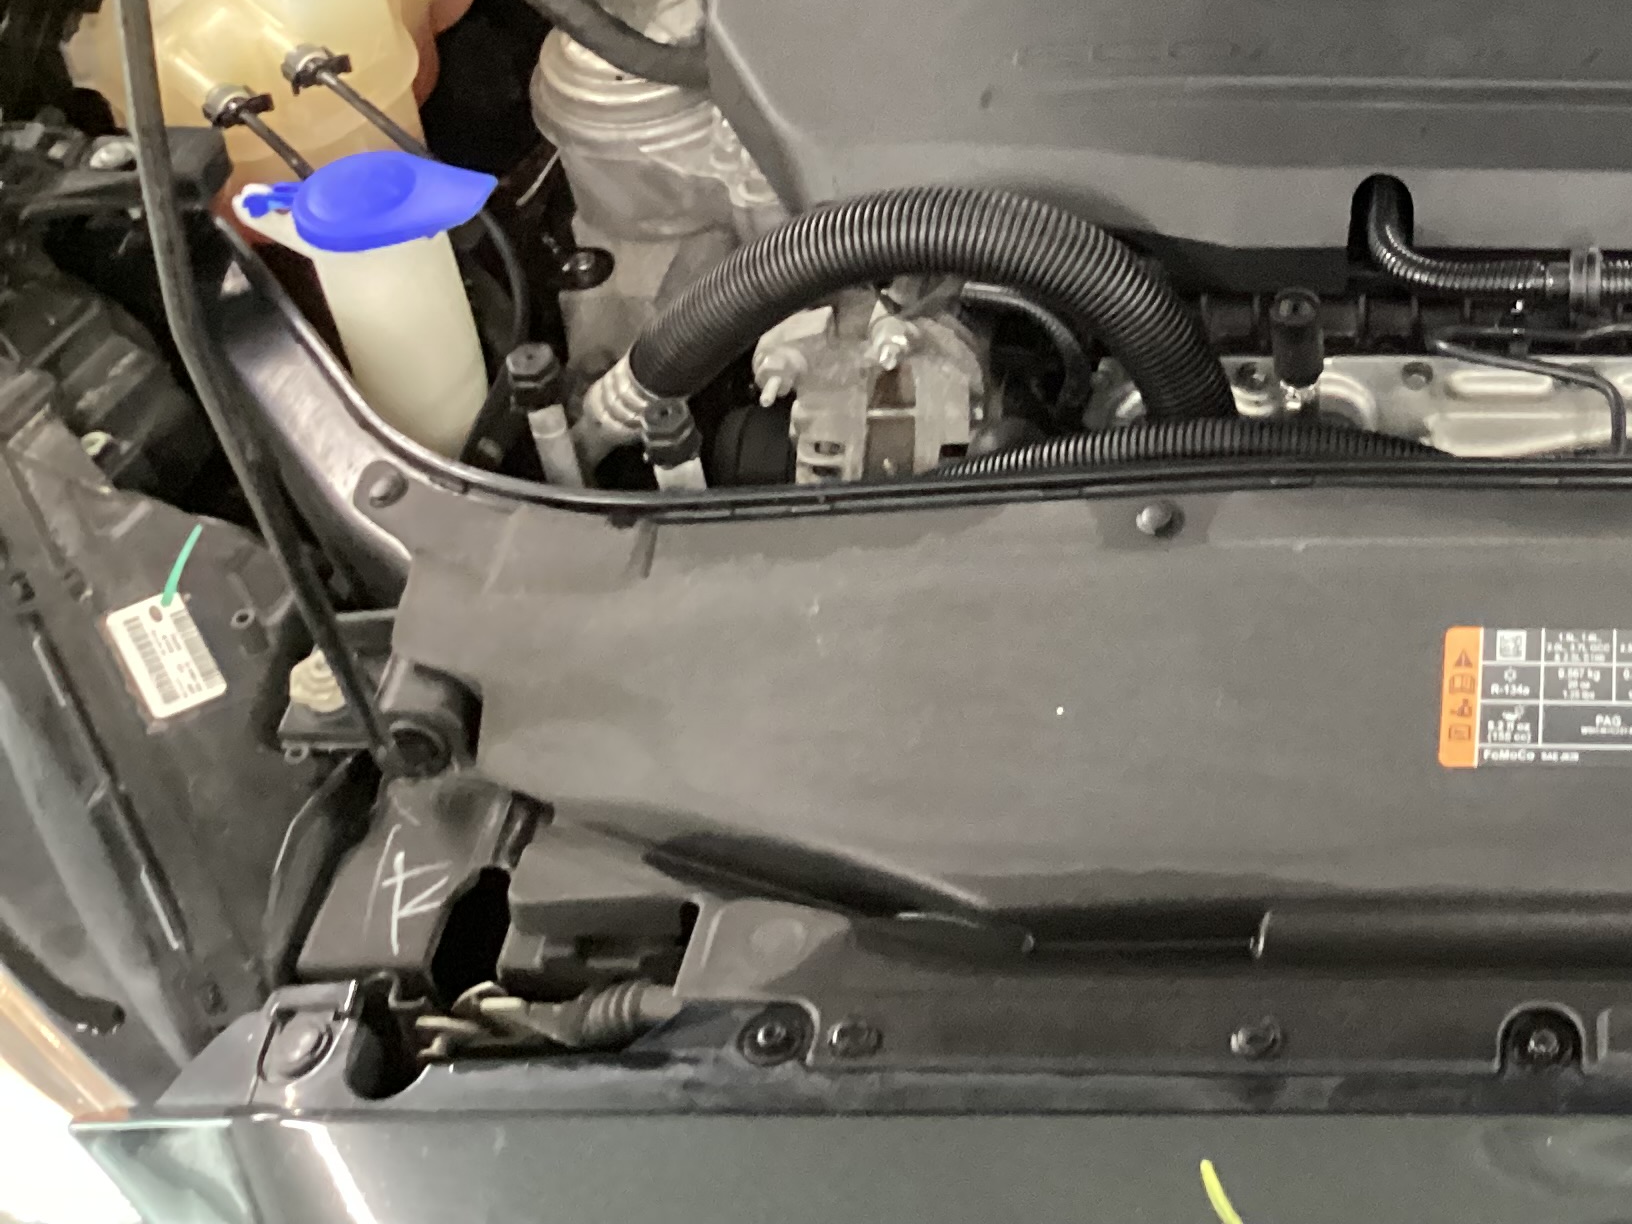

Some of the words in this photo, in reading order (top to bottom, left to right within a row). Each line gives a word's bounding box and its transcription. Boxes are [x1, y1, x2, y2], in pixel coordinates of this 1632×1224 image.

[1586, 666, 1601, 683] kg
[1490, 682, 1531, 696] R-134a
[1595, 712, 1622, 727] PAG
[1483, 748, 1536, 762] FoMoCo
